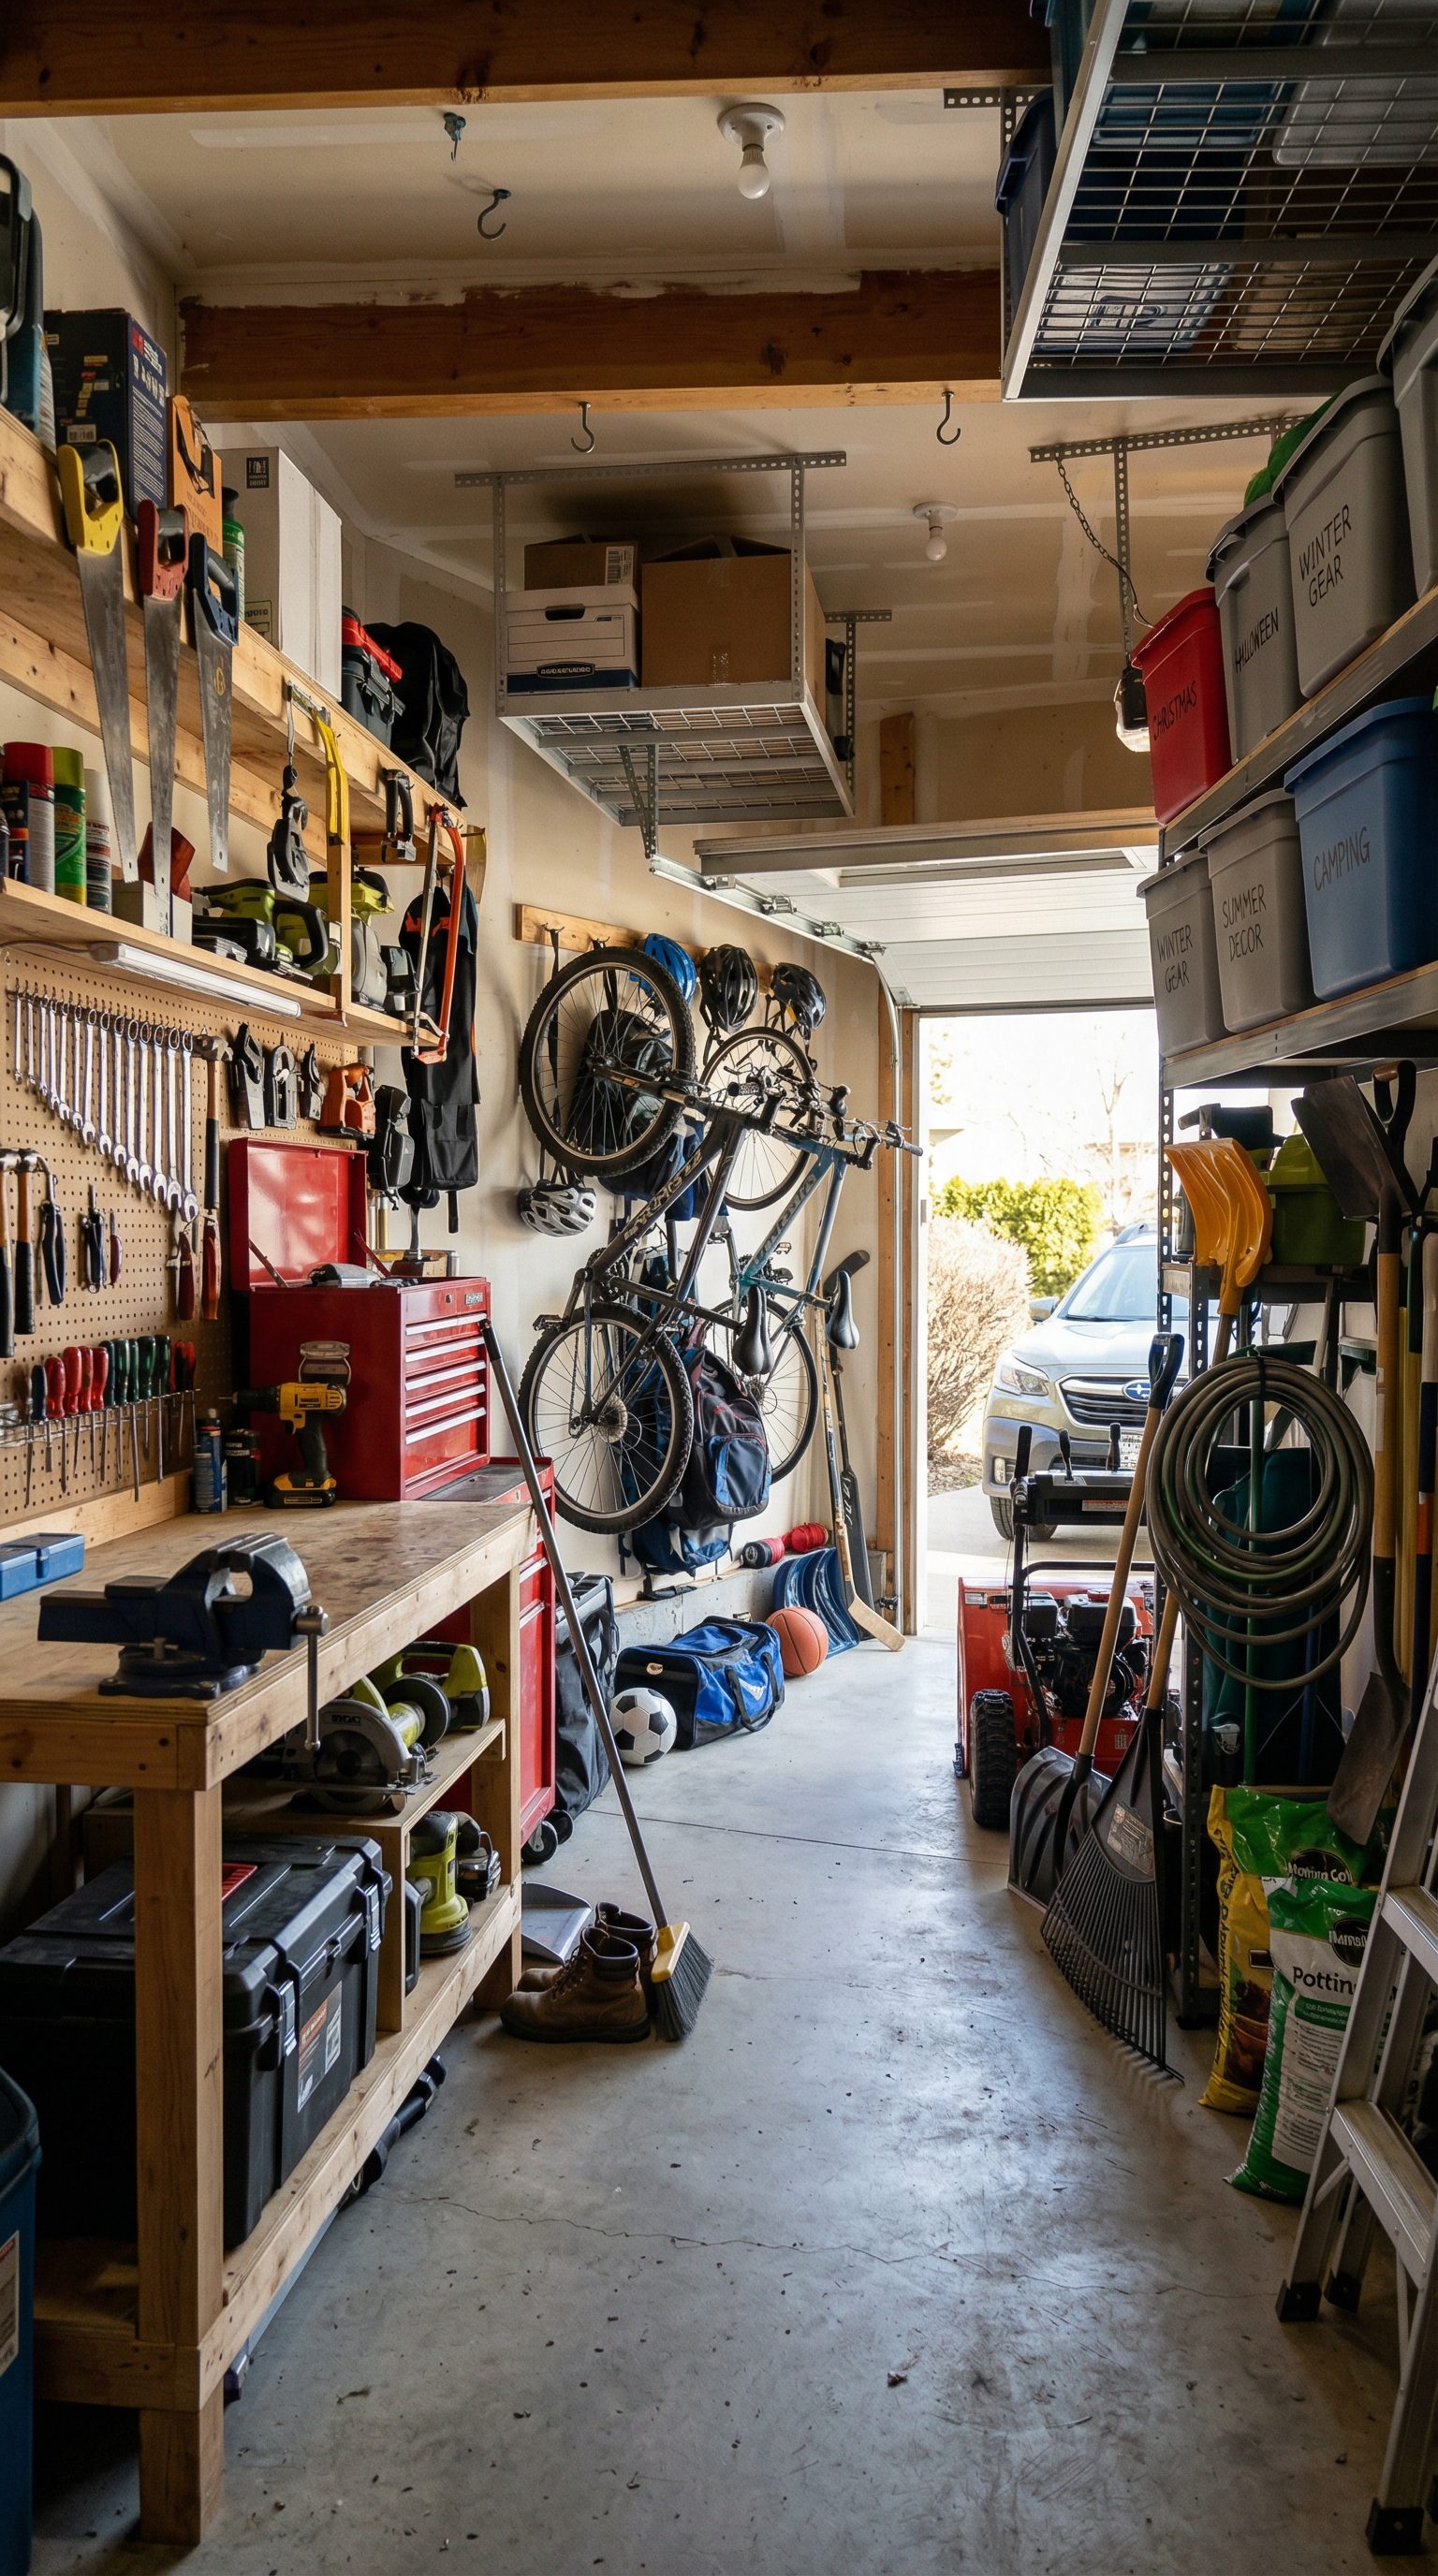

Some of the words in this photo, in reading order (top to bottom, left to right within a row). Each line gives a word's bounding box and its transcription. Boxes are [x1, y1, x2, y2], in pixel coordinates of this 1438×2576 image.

[1299, 504, 1352, 581] WINTER
[1309, 554, 1343, 607] GEAR
[1313, 826, 1371, 891] CAMPING
[1222, 884, 1267, 929] SUMMER
[1156, 924, 1194, 963] WINTER
[1228, 923, 1264, 962] DECOR
[1165, 960, 1190, 993] GEAR
[1292, 1966, 1357, 1996] Pottin
